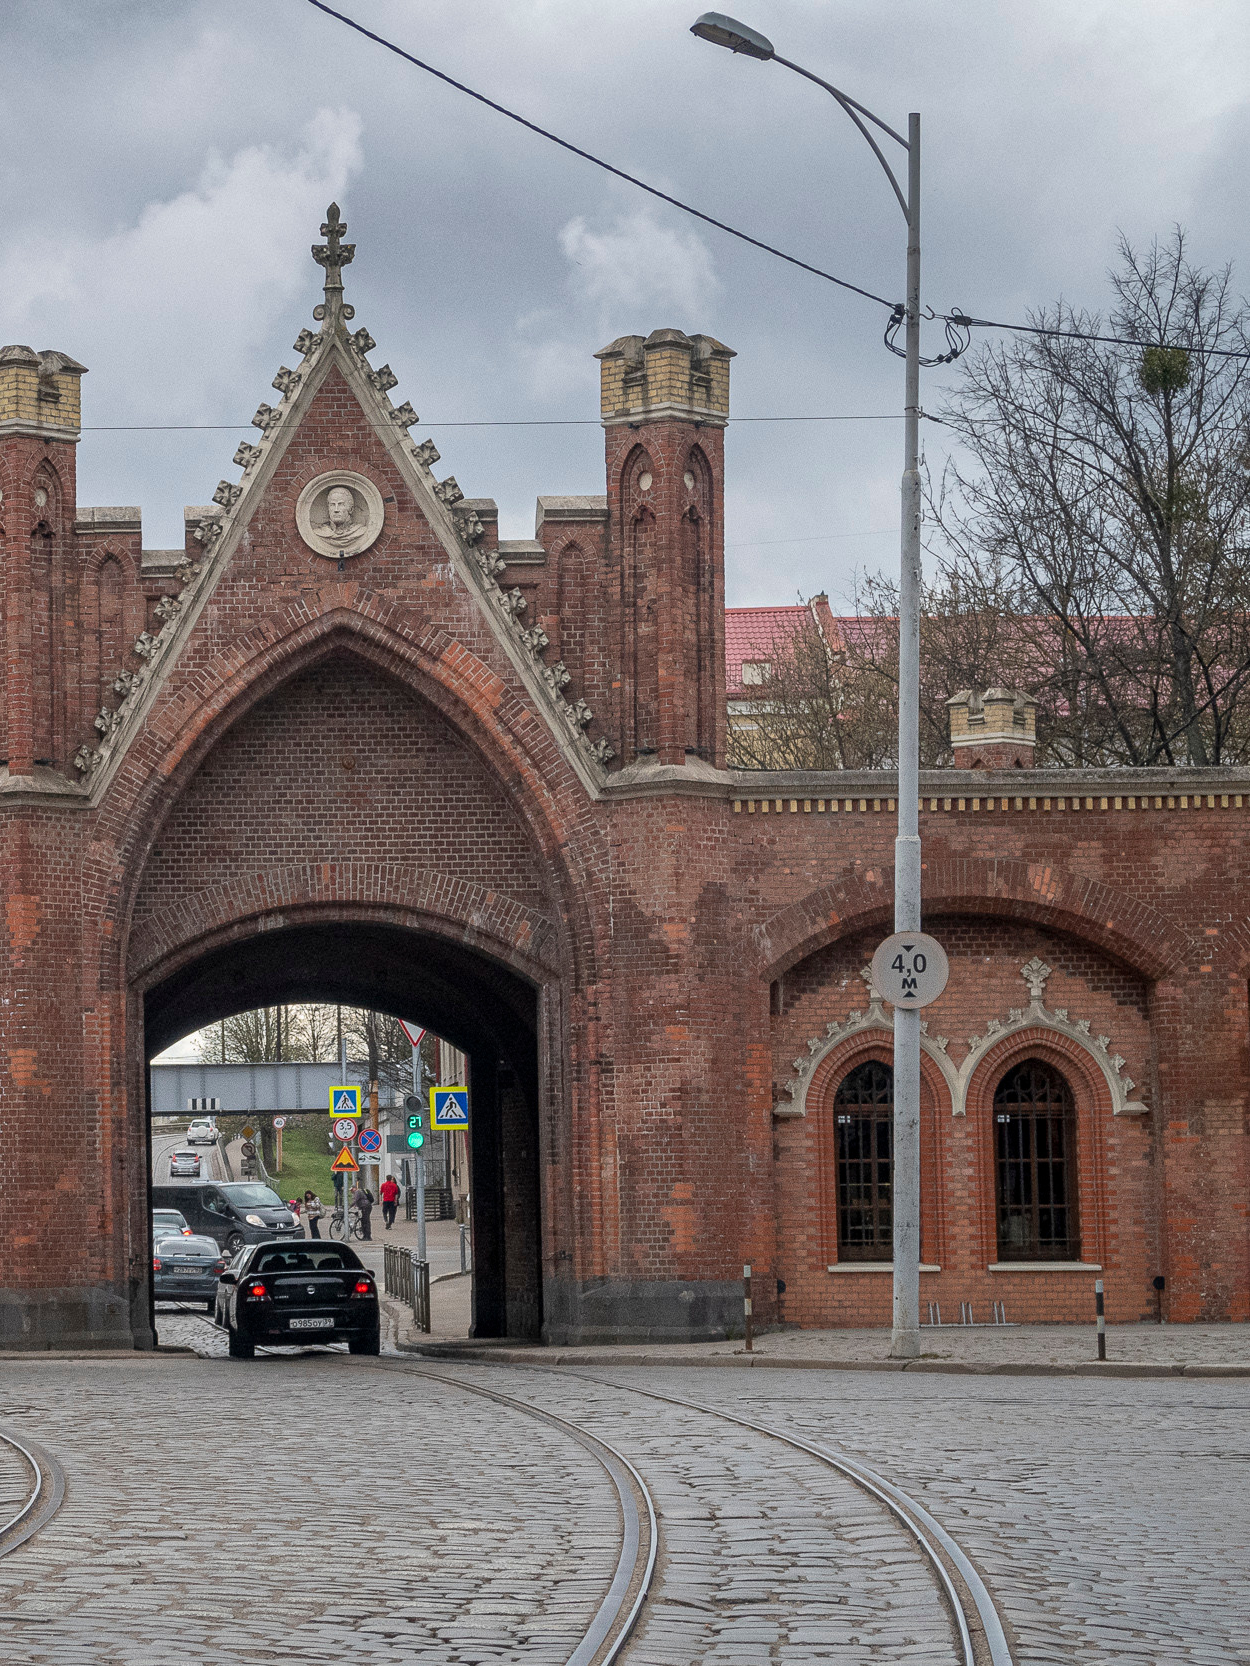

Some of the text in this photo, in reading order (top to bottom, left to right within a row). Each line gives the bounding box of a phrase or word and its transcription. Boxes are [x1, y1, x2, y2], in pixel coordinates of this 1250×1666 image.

[891, 953, 927, 977] 4,0
[339, 1122, 352, 1131] 3,5
[409, 1116, 422, 1128] 27
